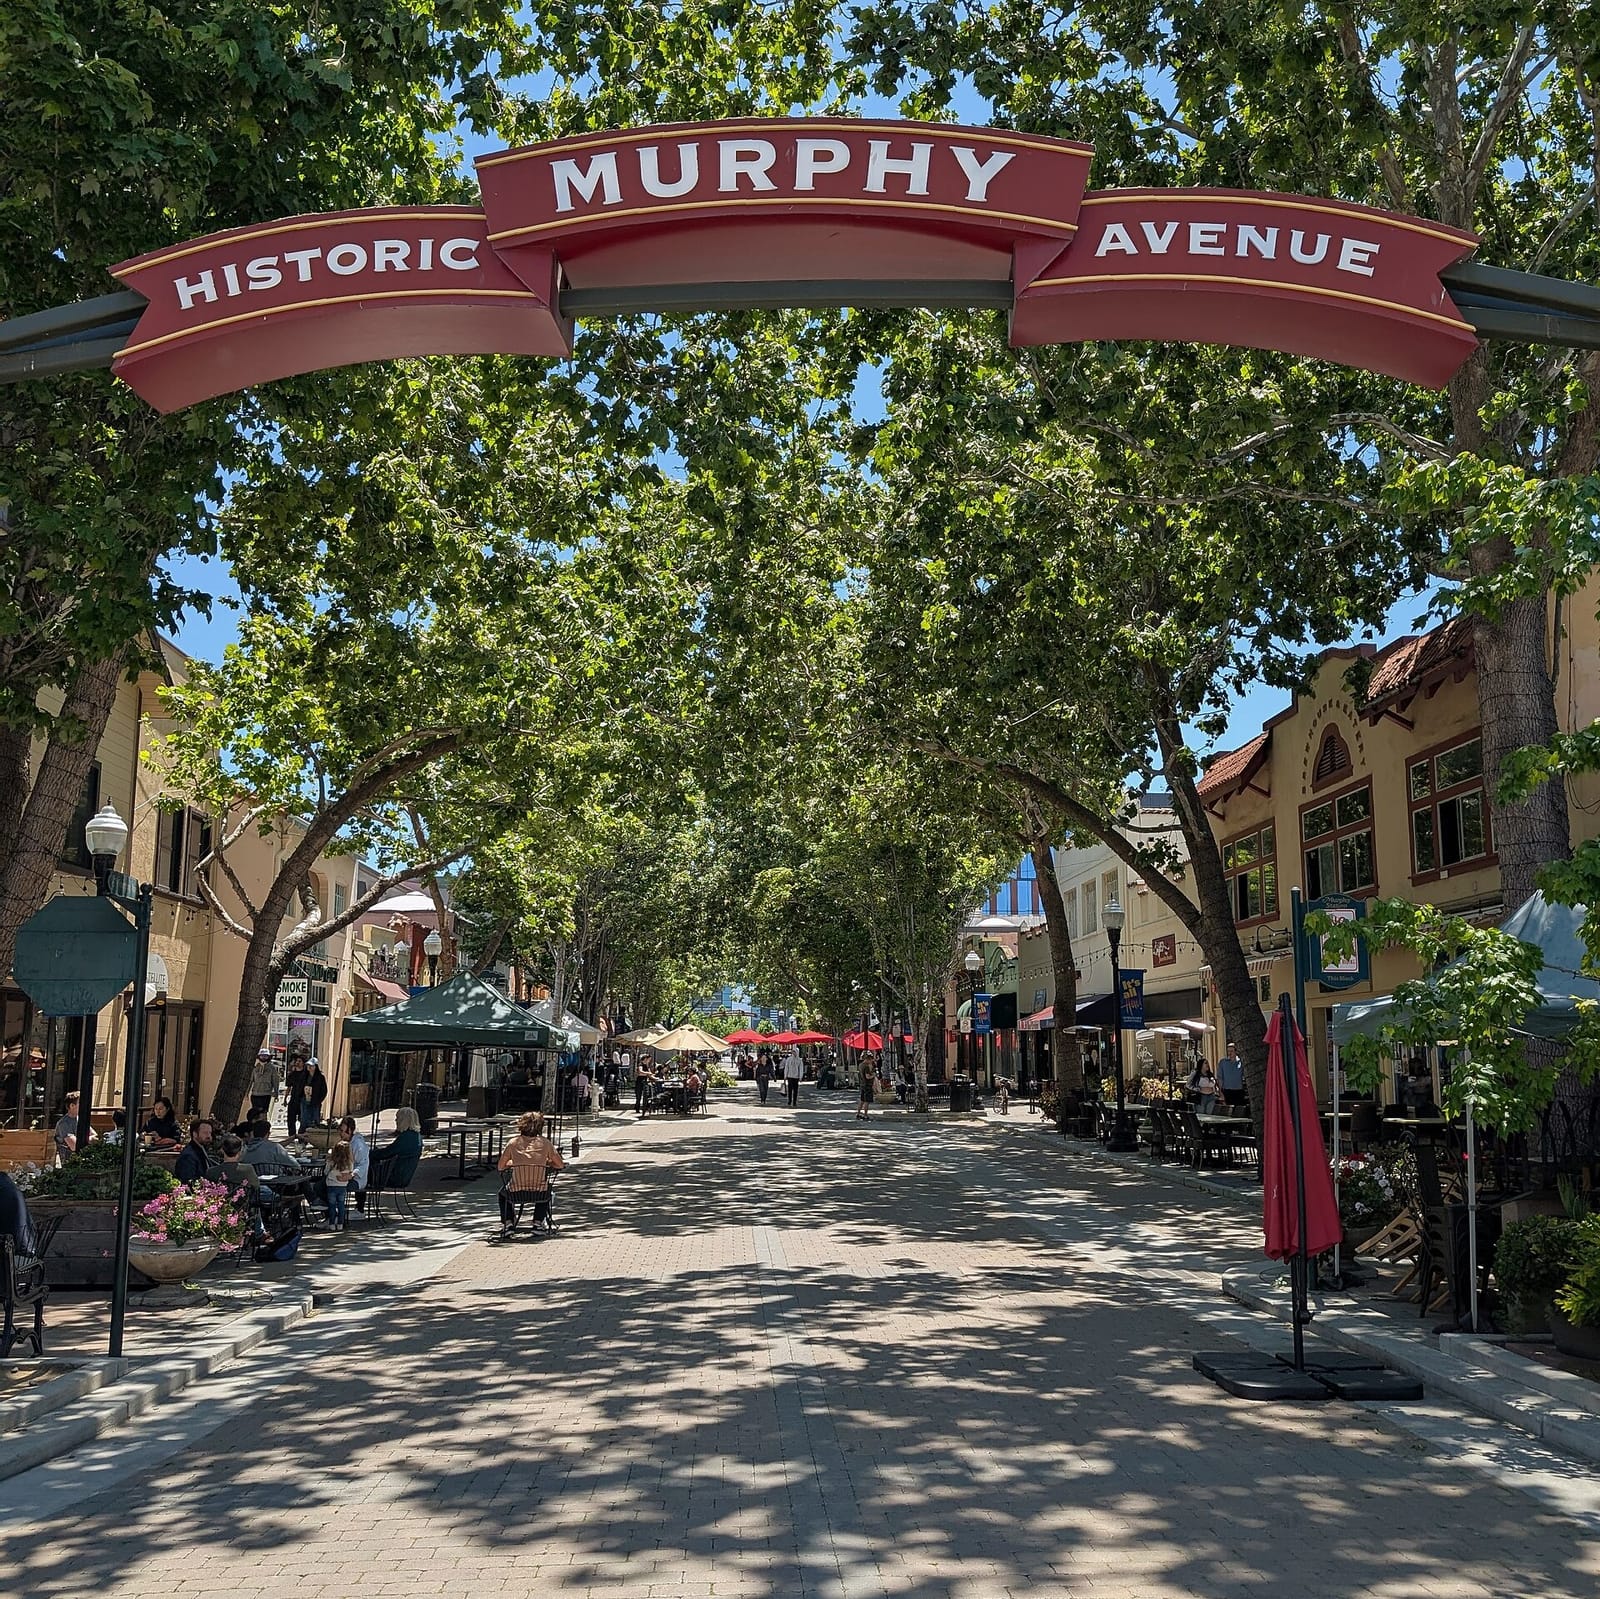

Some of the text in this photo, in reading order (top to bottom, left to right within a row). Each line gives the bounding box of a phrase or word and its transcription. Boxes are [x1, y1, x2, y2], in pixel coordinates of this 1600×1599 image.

[173, 138, 1380, 310] HISTORIC MURPHY AVENUE
[276, 981, 307, 993] SMOKE
[279, 995, 303, 1007] SHOP
